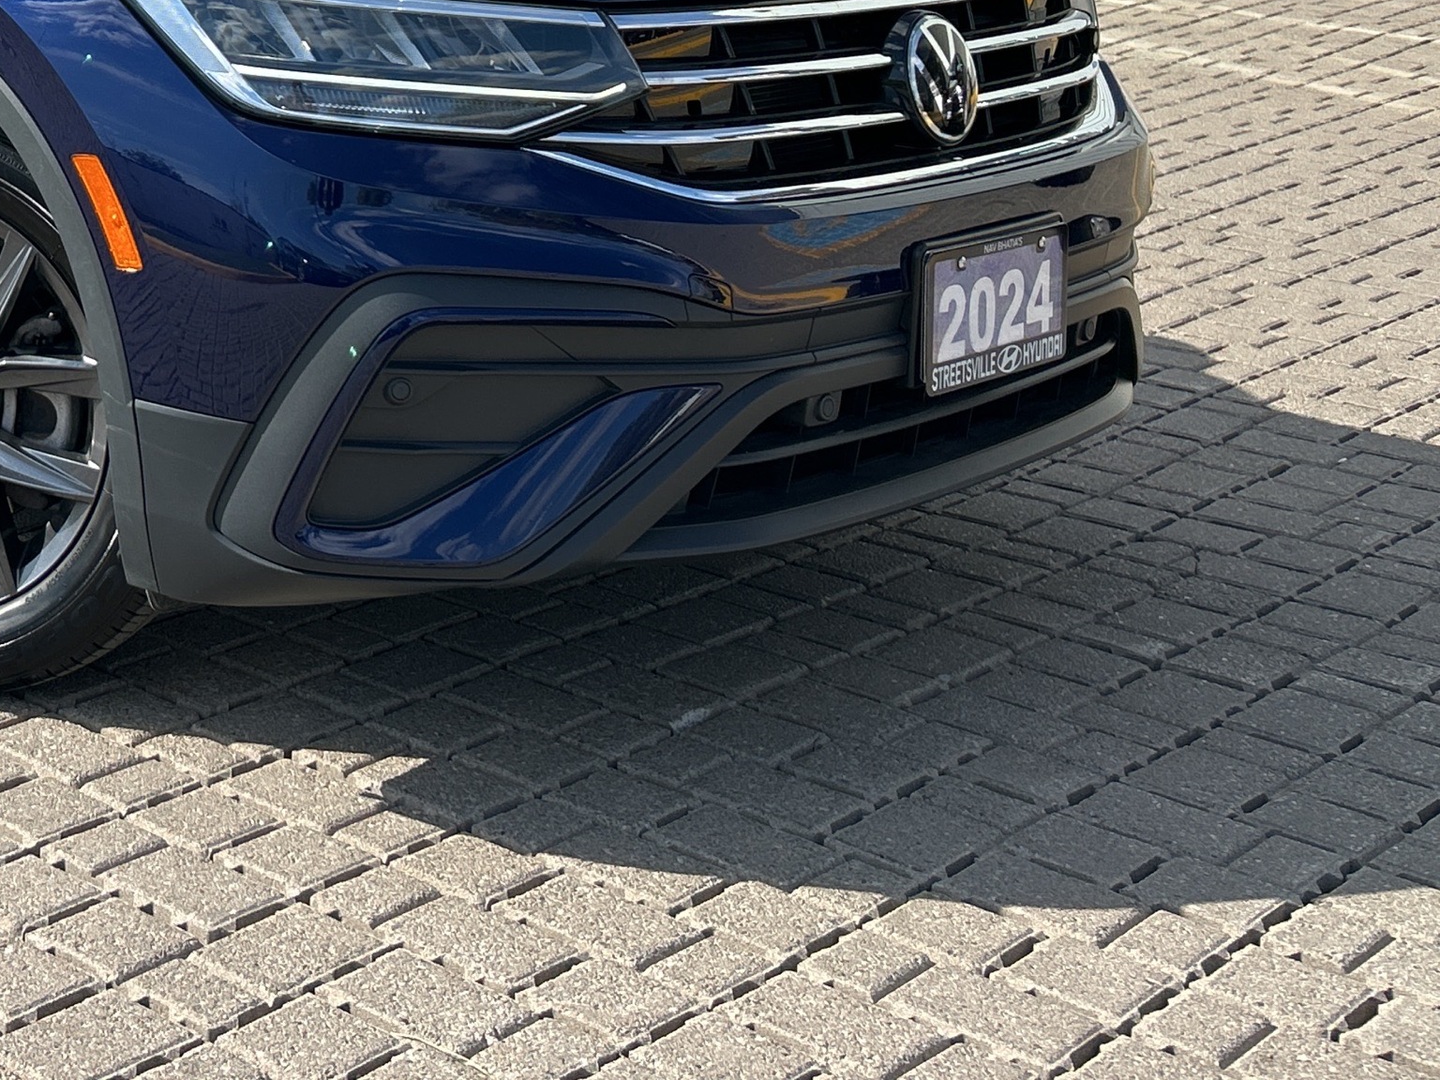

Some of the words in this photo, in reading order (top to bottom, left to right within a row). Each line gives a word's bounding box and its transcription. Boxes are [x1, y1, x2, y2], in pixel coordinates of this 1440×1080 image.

[937, 259, 1054, 364] 2024
[931, 351, 997, 392] STREETSVILLE
[1022, 333, 1063, 366] HYUNDAI
